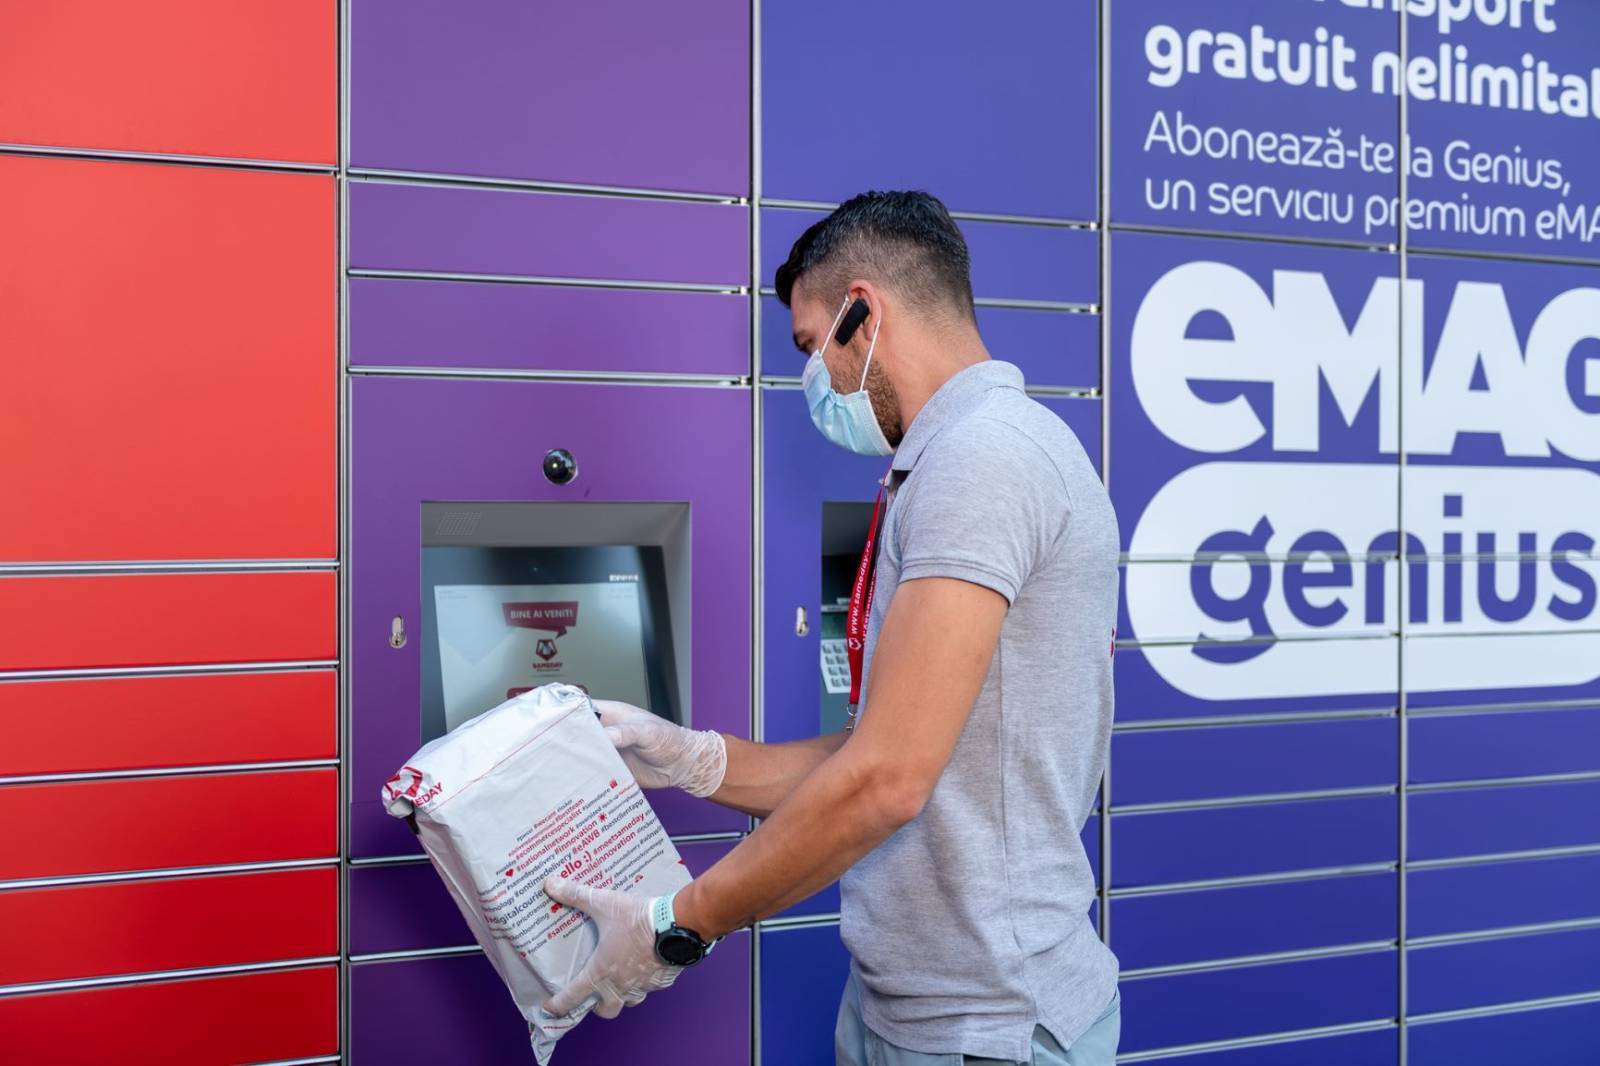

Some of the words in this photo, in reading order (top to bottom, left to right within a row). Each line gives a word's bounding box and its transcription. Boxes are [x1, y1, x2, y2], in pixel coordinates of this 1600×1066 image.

[1144, 24, 1358, 91] gratuit
[1144, 110, 1394, 174] Abonează-te
[1404, 134, 1433, 178] la
[1443, 140, 1571, 197] Genius,
[1145, 178, 1196, 211] un
[1208, 181, 1354, 223] serviciu
[1364, 193, 1526, 236] premium
[1131, 261, 1600, 461] eMAG
[1190, 493, 1597, 664] genius
[511, 610, 531, 619] BINE
[533, 610, 543, 618] AI
[505, 853, 555, 890] #samedaydelivery
[554, 819, 598, 855] #innovation
[513, 851, 573, 898] #ontimedelivery
[570, 828, 600, 855] #eAWB
[600, 797, 644, 832] #bestclientapp
[514, 807, 582, 860] #ecommercespecialist
[515, 825, 575, 872] #nationalnetwork
[557, 856, 583, 879] ello
[592, 812, 646, 855] #meetsameday
